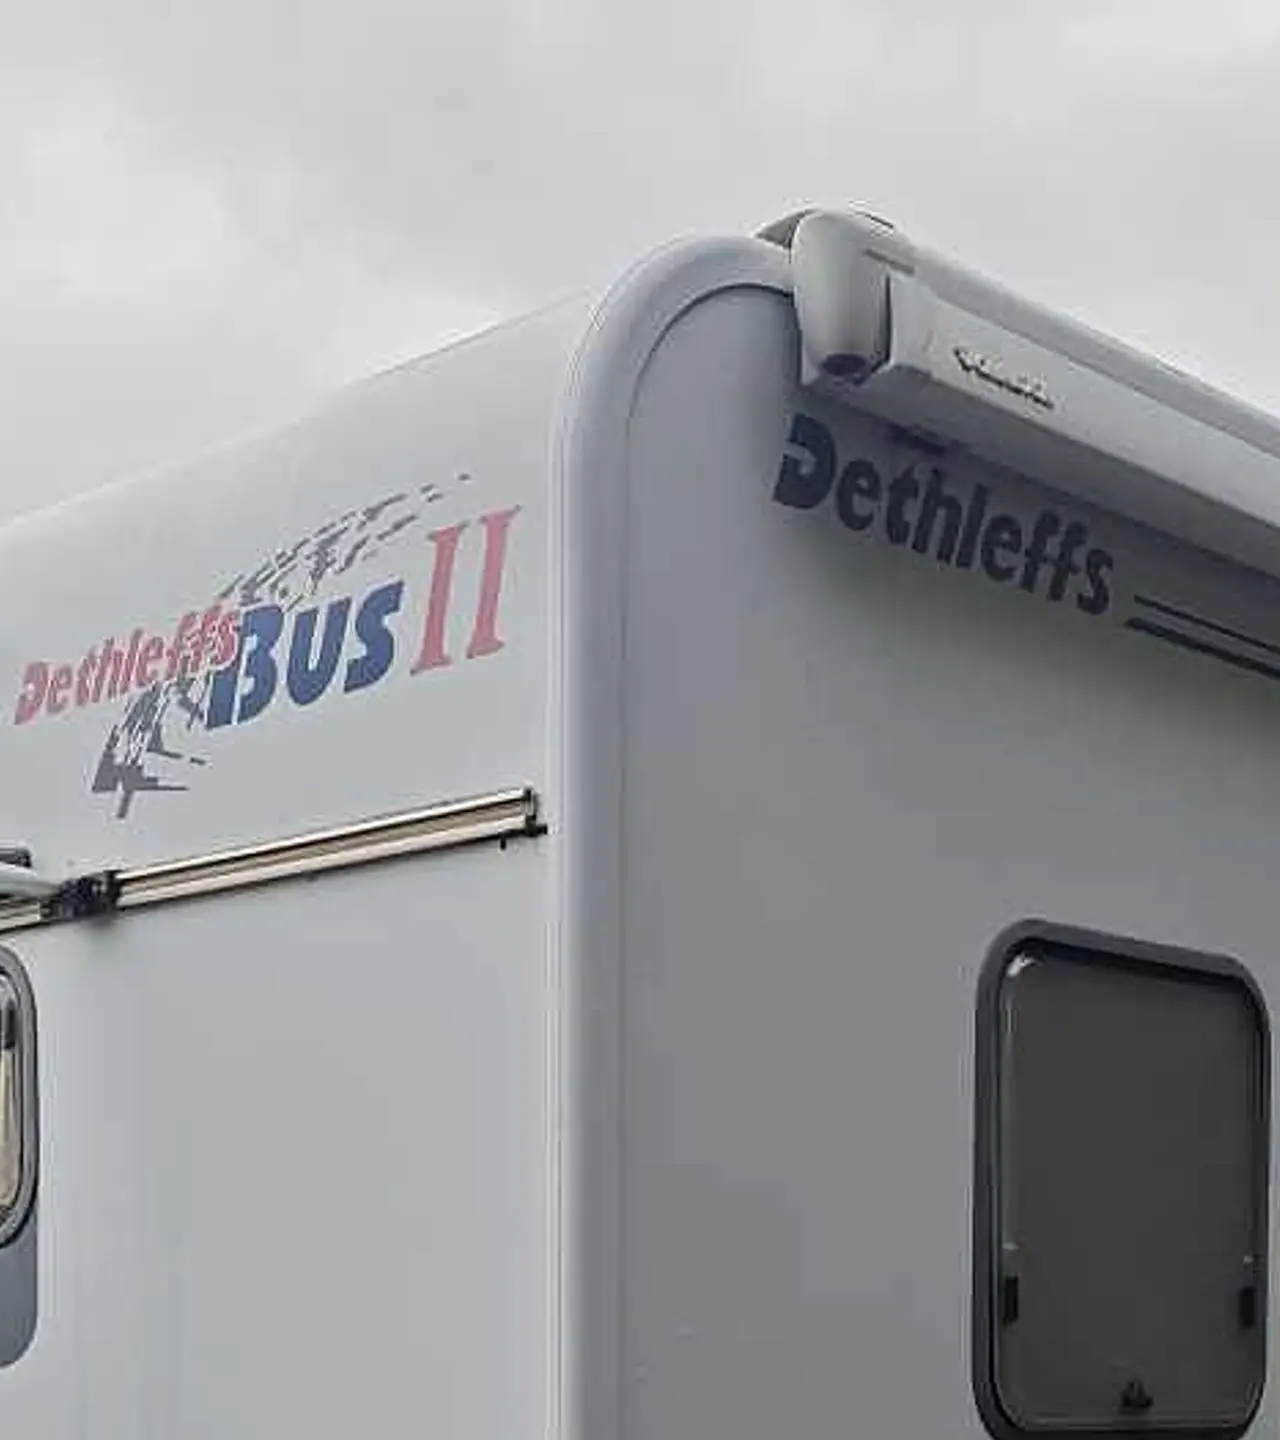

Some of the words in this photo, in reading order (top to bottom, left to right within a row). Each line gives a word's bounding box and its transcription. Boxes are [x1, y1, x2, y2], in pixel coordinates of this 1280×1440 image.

[15, 604, 239, 725] Dethleffs
[409, 507, 521, 675] II
[774, 413, 1114, 616] Dethleffs
